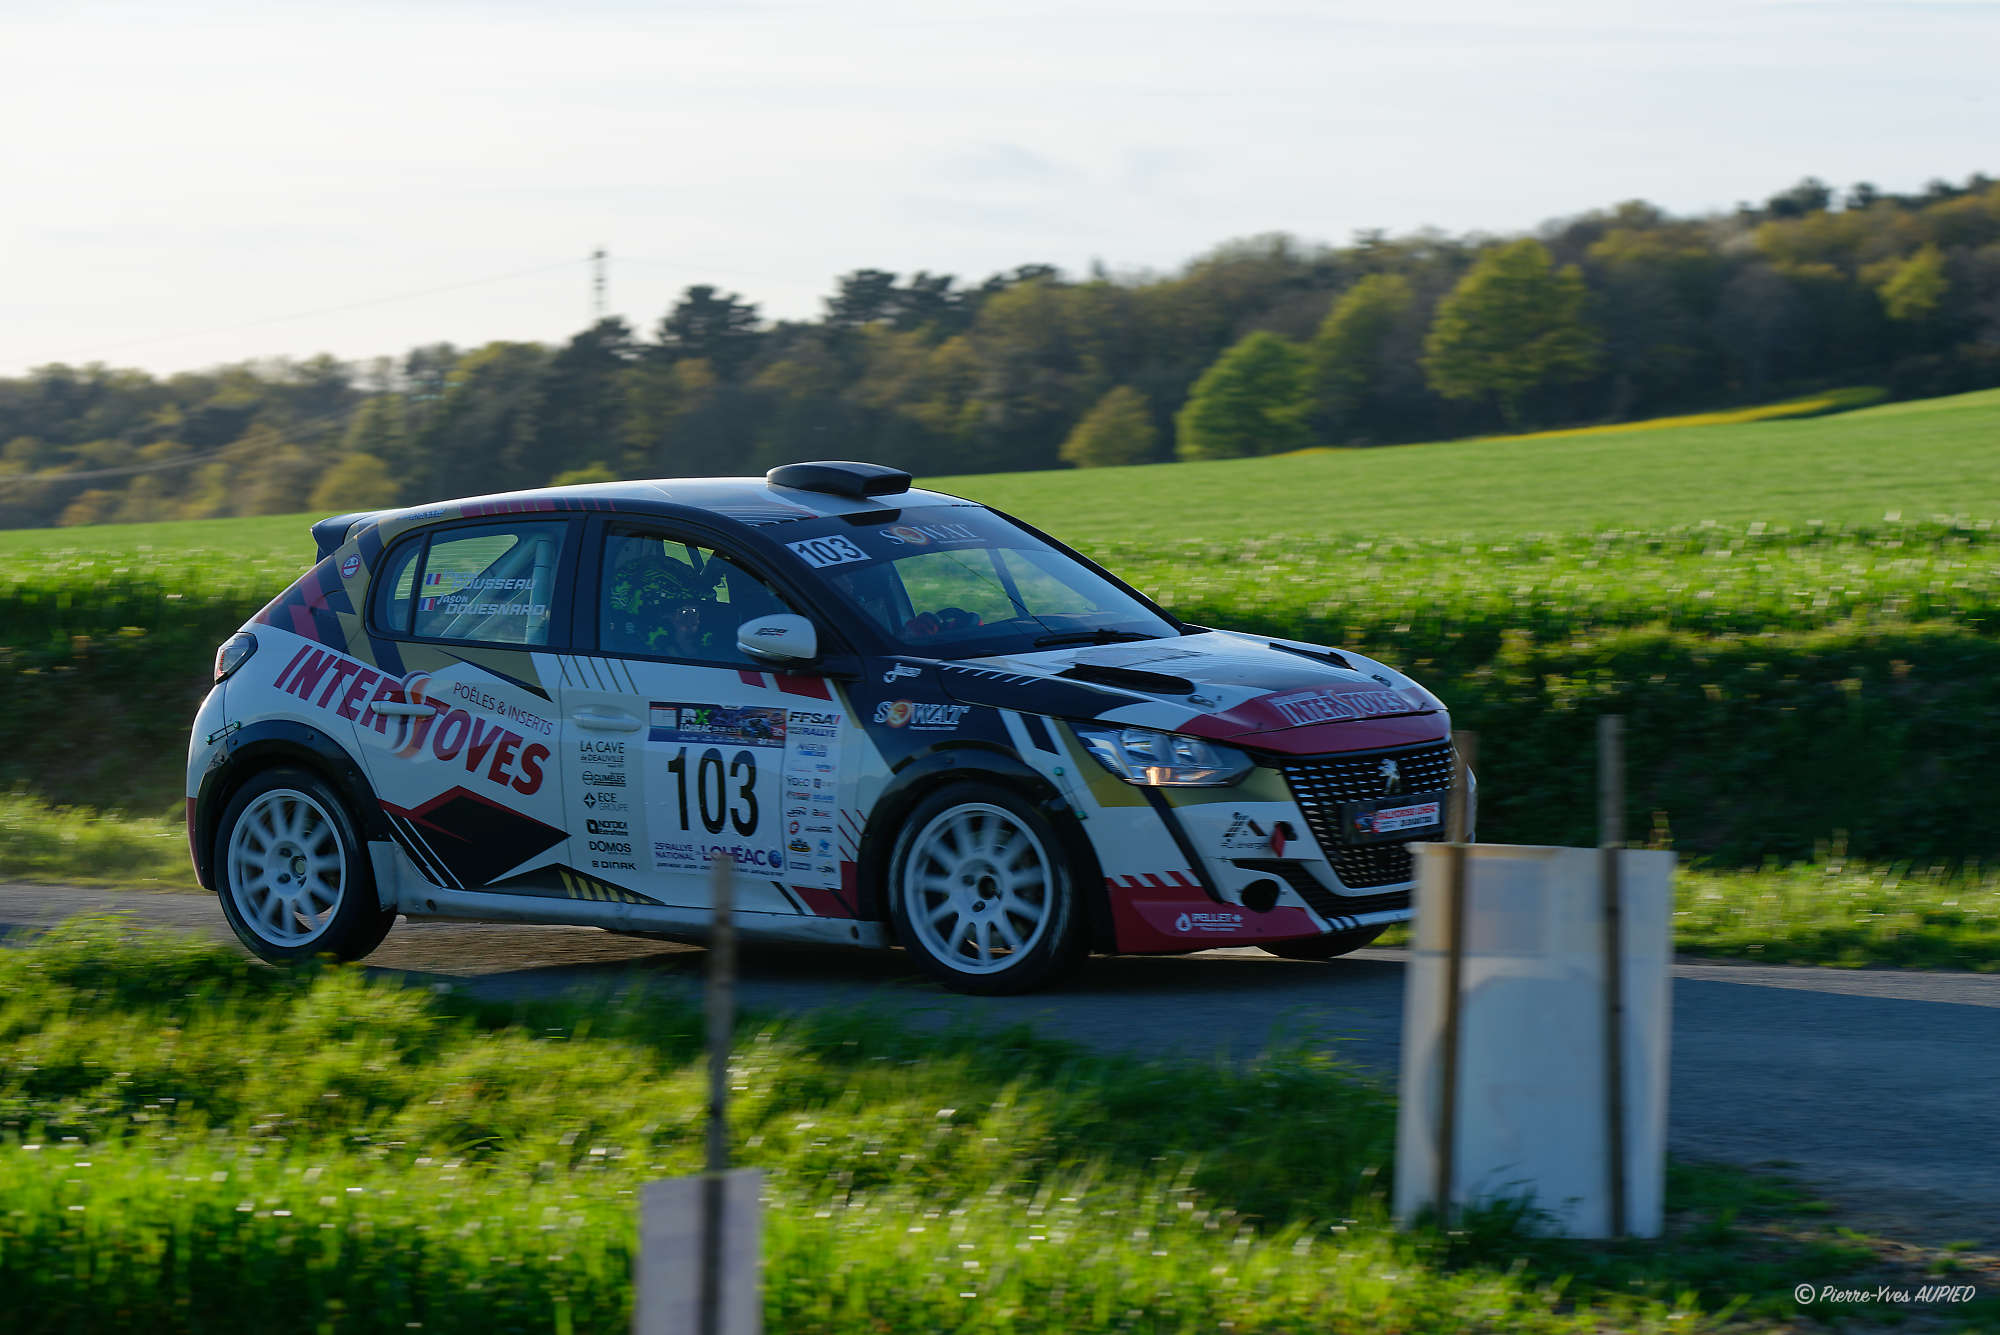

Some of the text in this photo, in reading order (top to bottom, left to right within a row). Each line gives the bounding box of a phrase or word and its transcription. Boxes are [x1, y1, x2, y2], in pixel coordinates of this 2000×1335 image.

[797, 537, 863, 565] 103
[444, 603, 546, 617] DOUESNARD
[453, 681, 554, 736] POÊLES & INSERTS
[789, 711, 833, 725] FFSA
[580, 741, 625, 754] LA CAVE
[598, 793, 617, 803] ECE
[667, 746, 759, 837] 103
[589, 840, 632, 853] DOMOS
